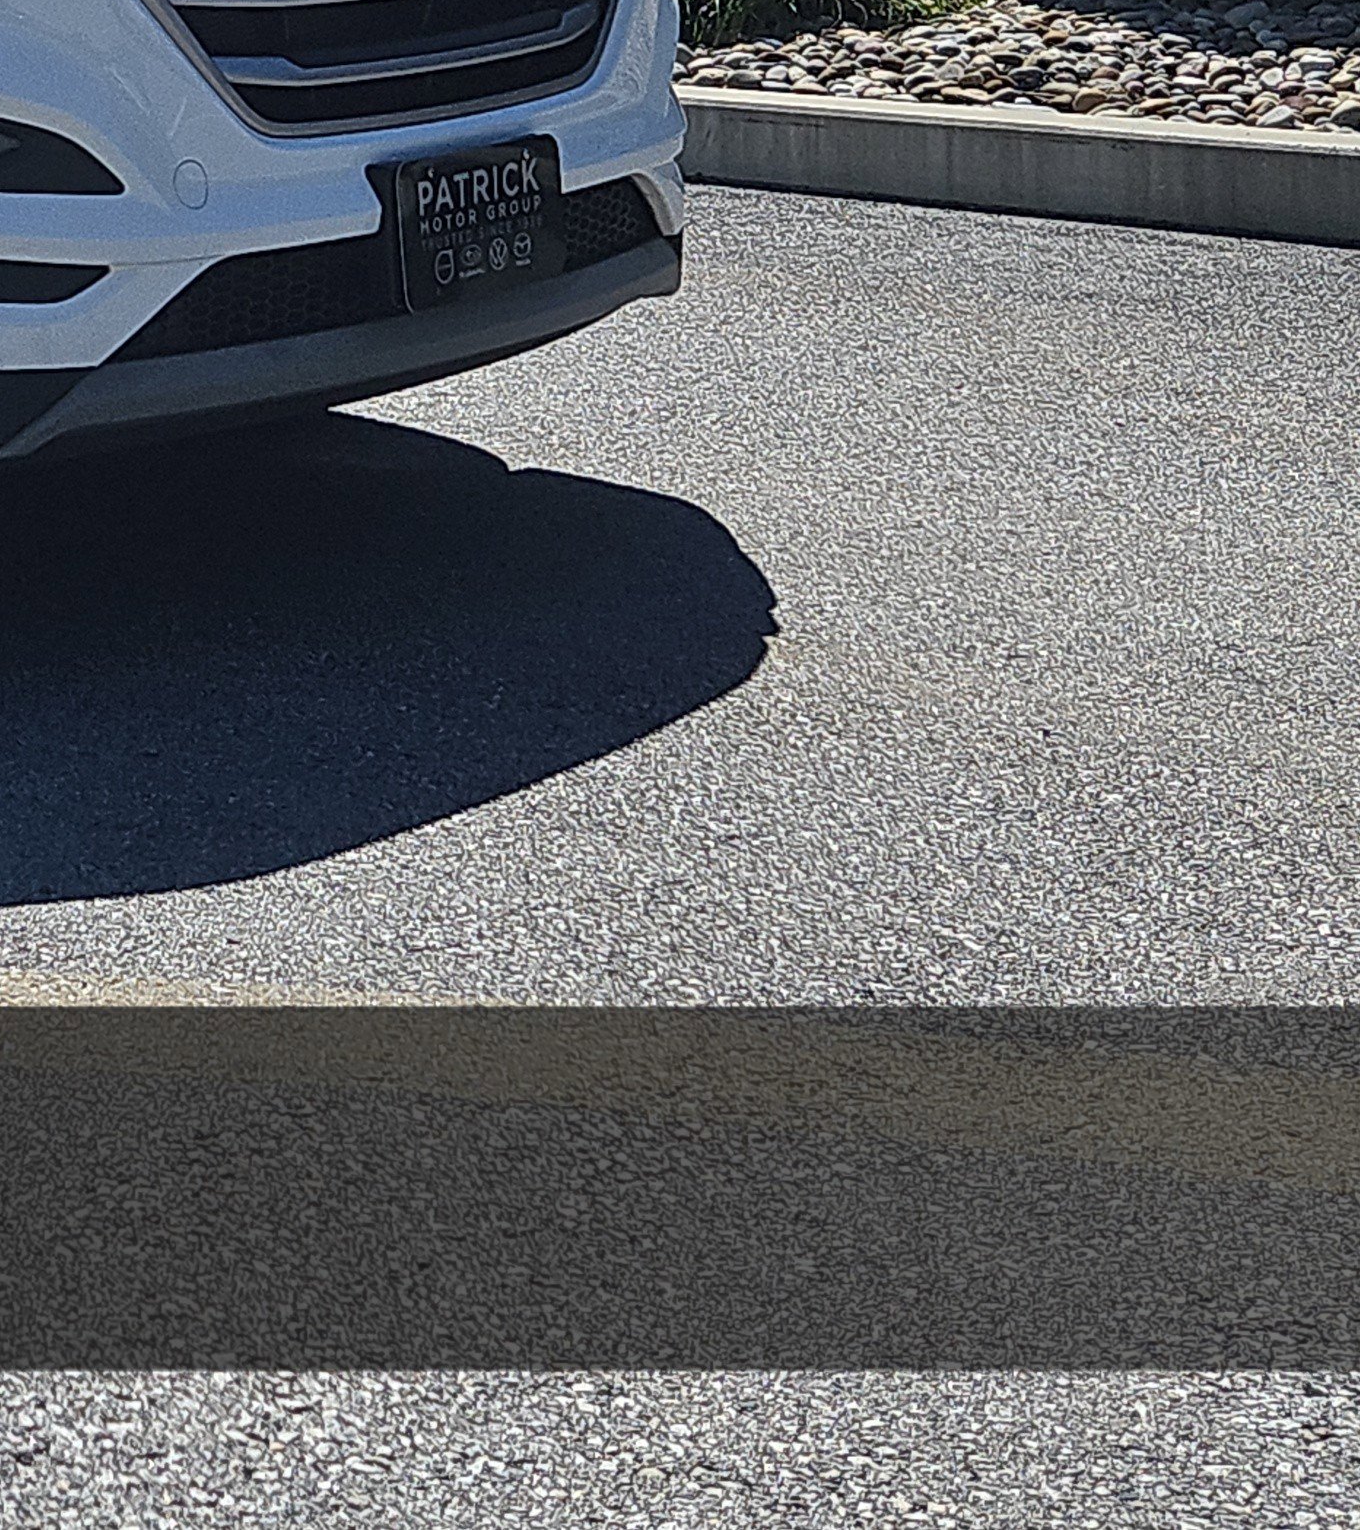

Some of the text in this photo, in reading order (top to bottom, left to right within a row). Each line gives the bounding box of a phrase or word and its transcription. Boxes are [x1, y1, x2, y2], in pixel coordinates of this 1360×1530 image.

[417, 157, 541, 217] PATRICK
[420, 194, 542, 235] MOTOR GROUP
